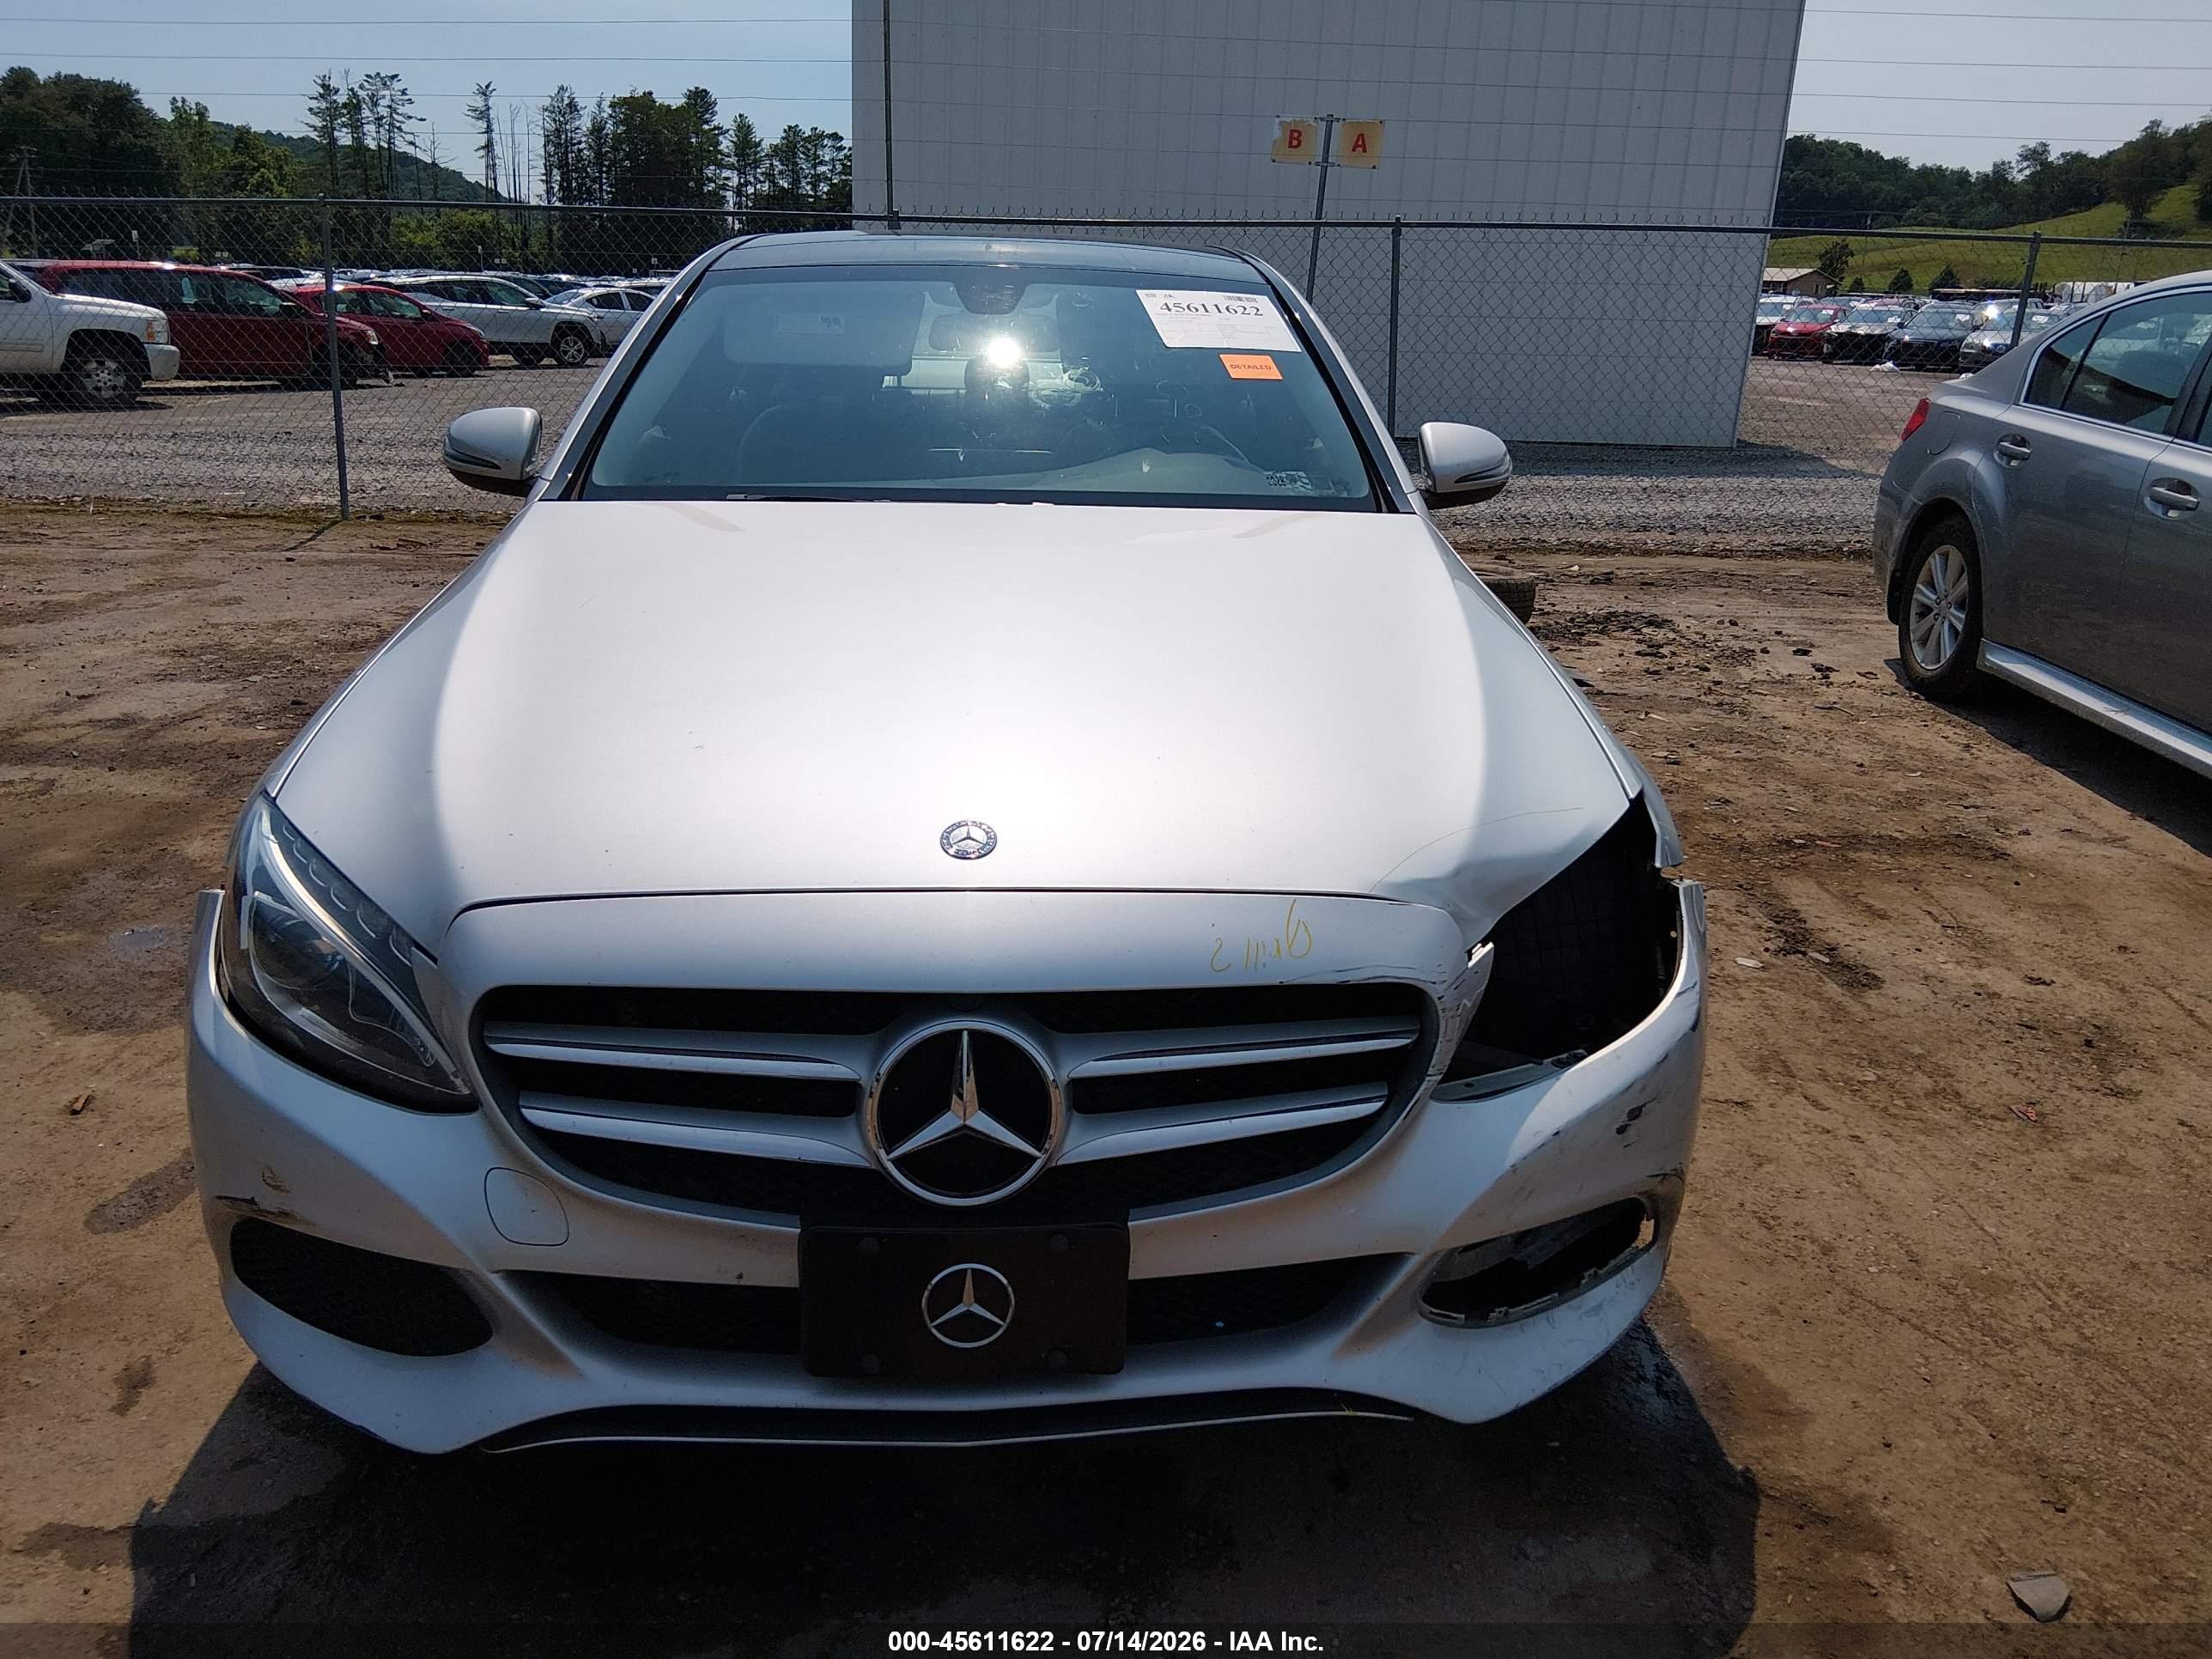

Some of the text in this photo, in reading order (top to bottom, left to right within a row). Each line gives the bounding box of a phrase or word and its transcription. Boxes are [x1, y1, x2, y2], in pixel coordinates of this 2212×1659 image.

[1288, 129, 1303, 149] B
[1352, 133, 1367, 153] A
[1159, 301, 1263, 316] 45611622
